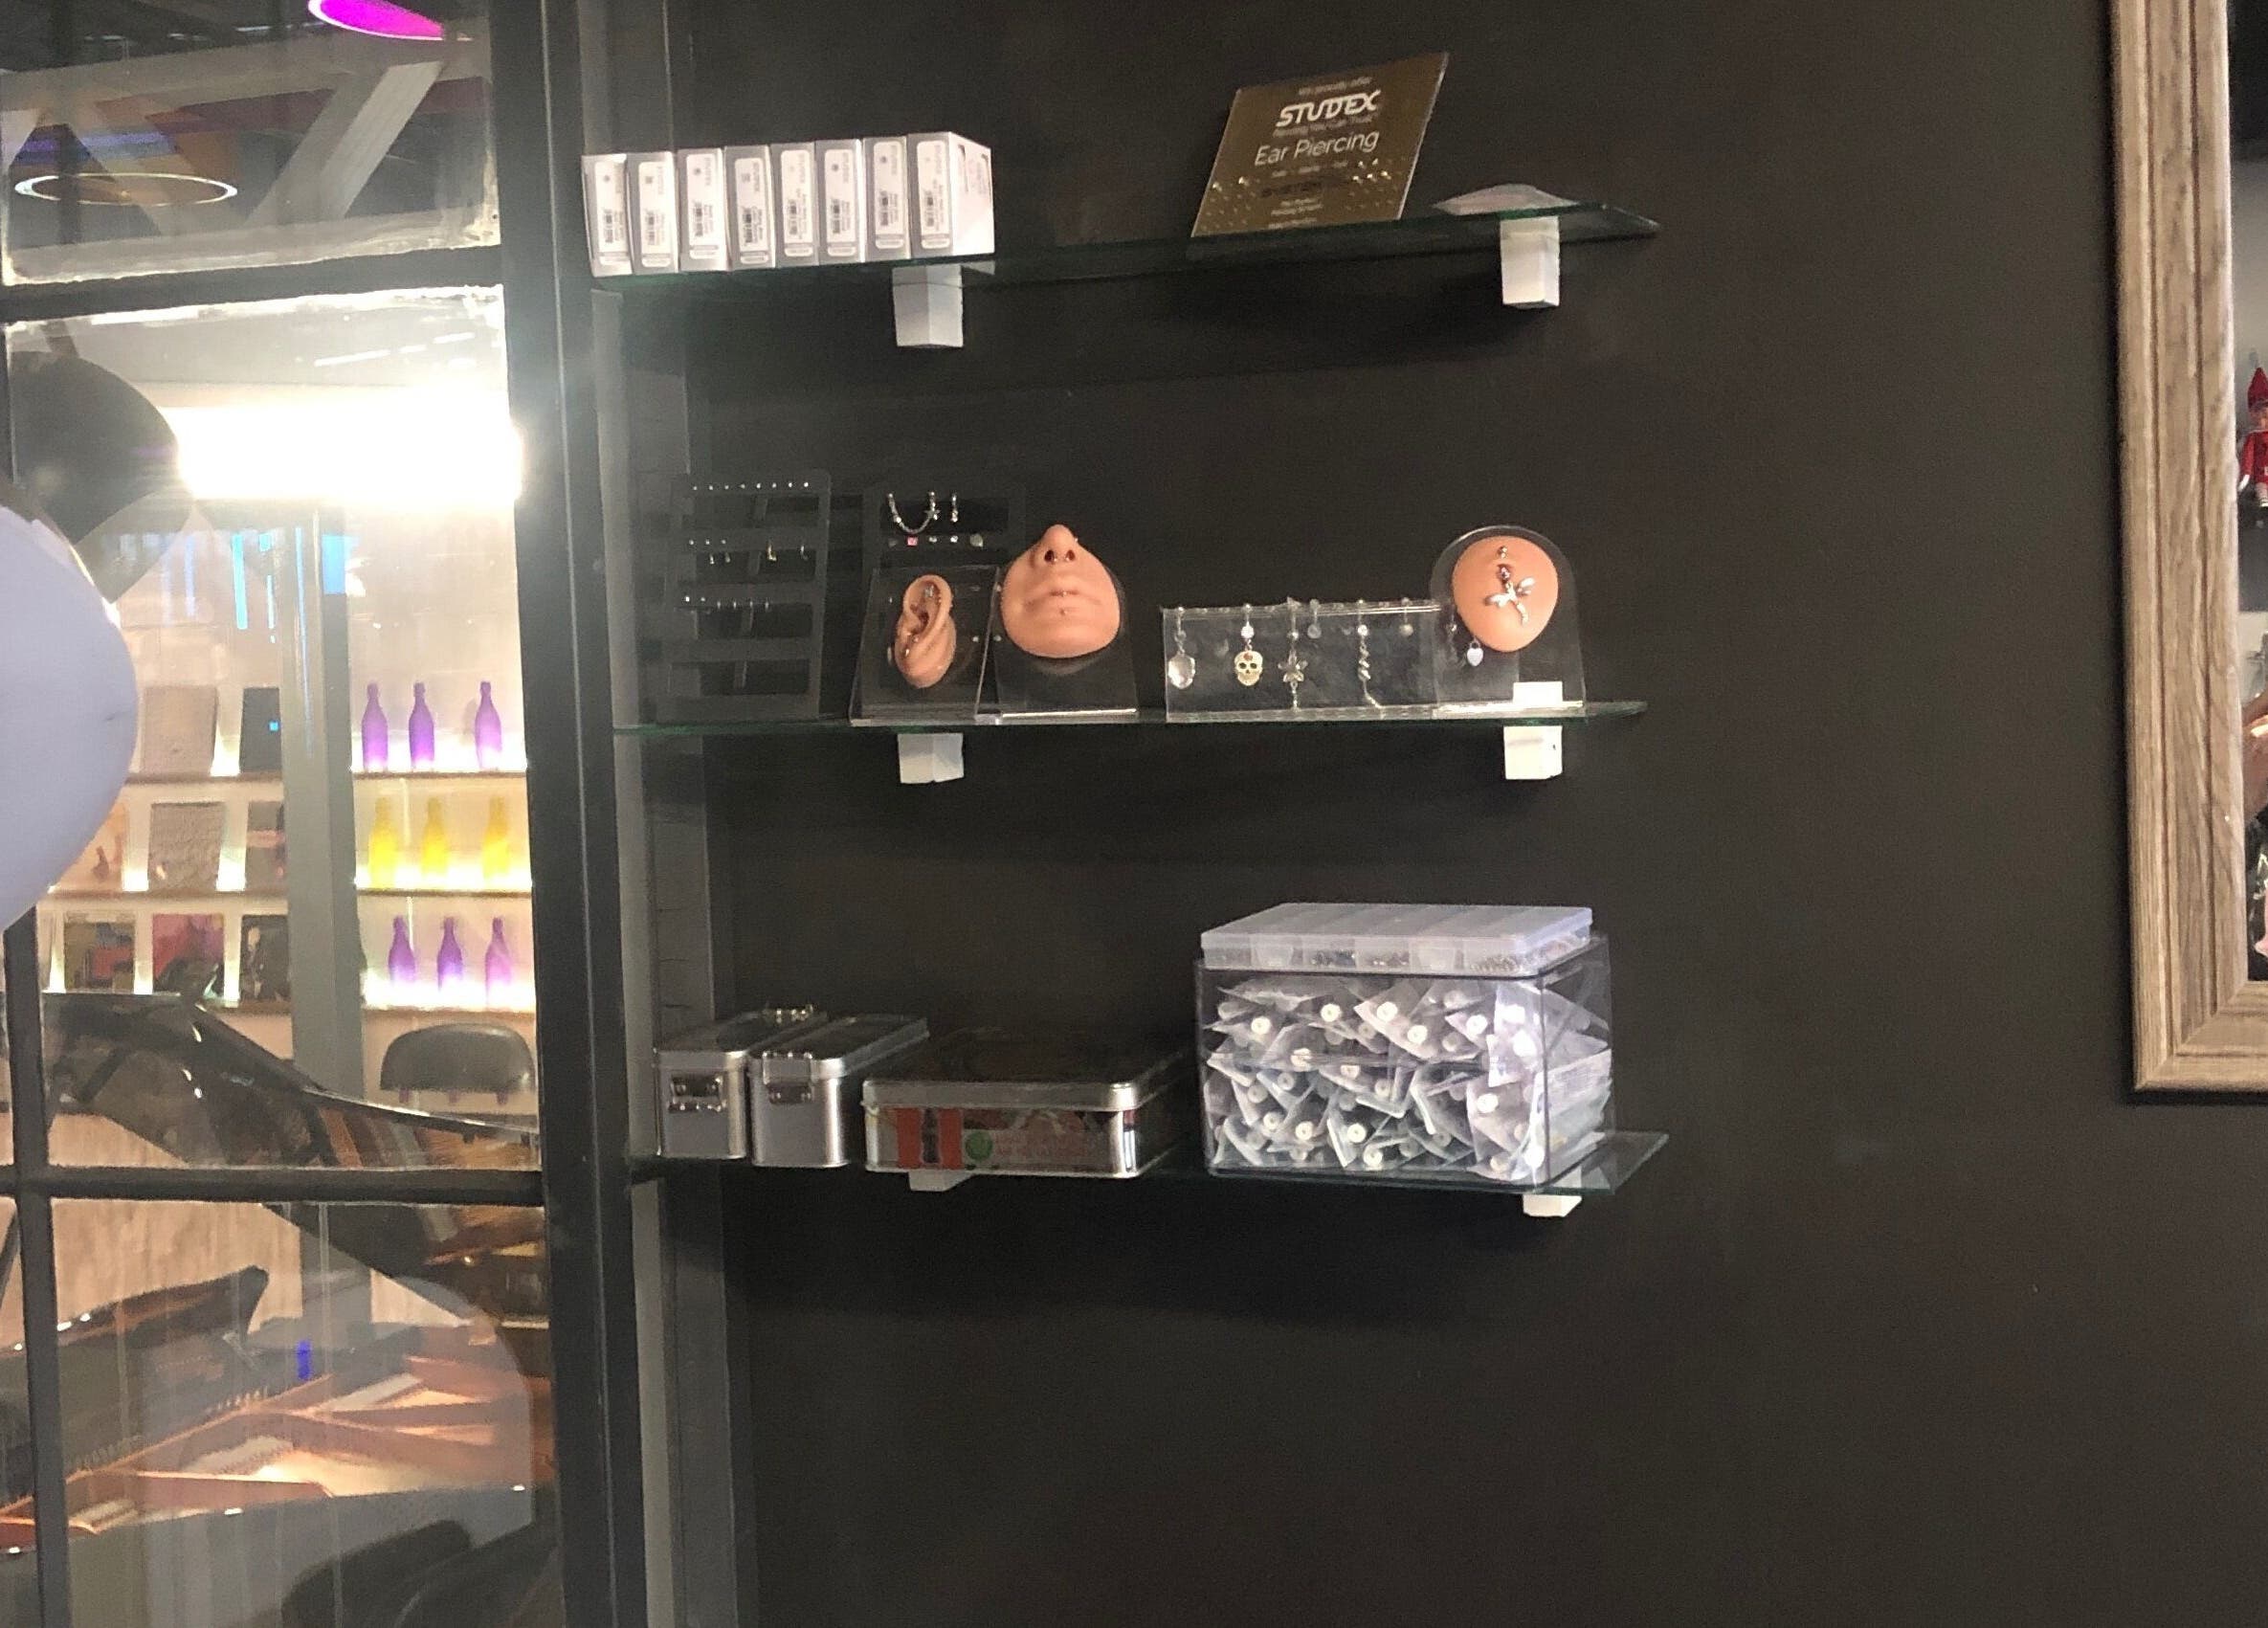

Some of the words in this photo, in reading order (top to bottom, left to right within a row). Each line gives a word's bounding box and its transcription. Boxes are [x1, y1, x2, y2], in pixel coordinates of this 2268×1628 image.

[1276, 89, 1381, 127] STUDEX
[1255, 145, 1289, 166] Ear
[1294, 131, 1380, 158] Piercing
